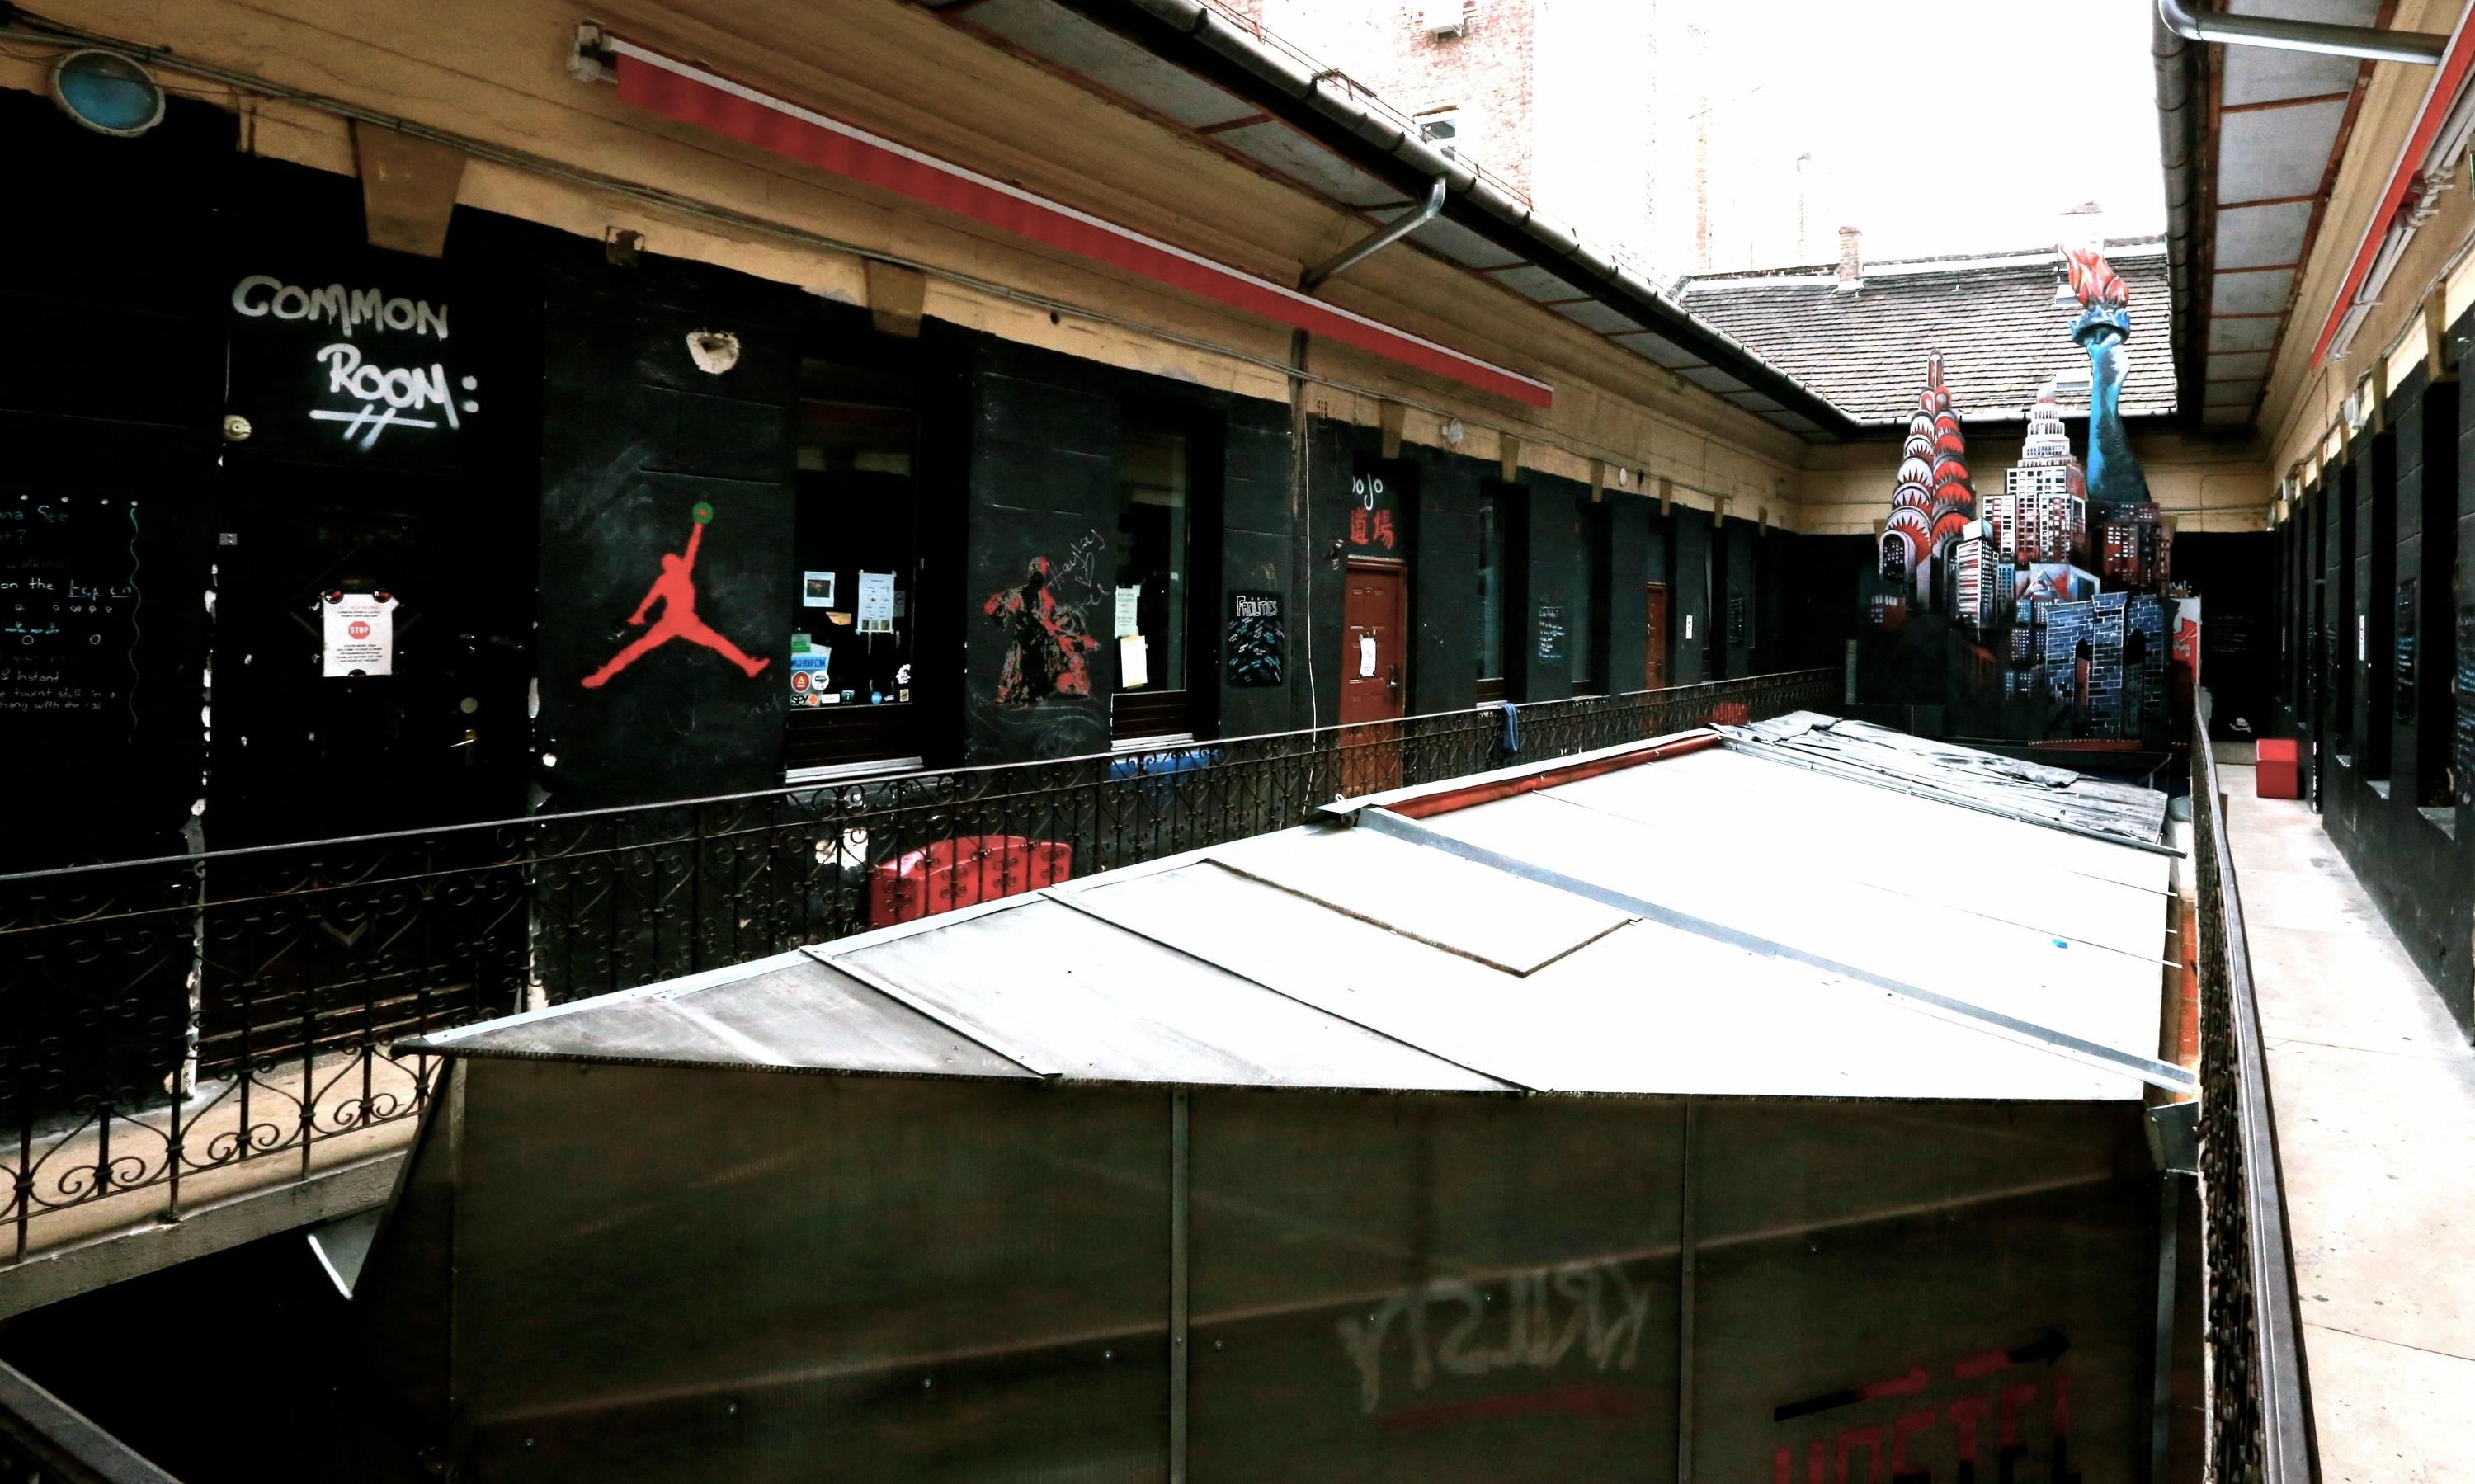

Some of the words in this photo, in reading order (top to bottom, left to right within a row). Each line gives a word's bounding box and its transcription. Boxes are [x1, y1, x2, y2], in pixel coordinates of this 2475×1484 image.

[232, 275, 449, 340] COMMON
[316, 342, 479, 429] ROOM:
[1350, 506, 1395, 551] 道場
[28, 577, 54, 591] the
[349, 626, 370, 634] STOP
[14, 687, 52, 698] tourist
[58, 687, 82, 699] stuff
[790, 695, 809, 706] SPY
